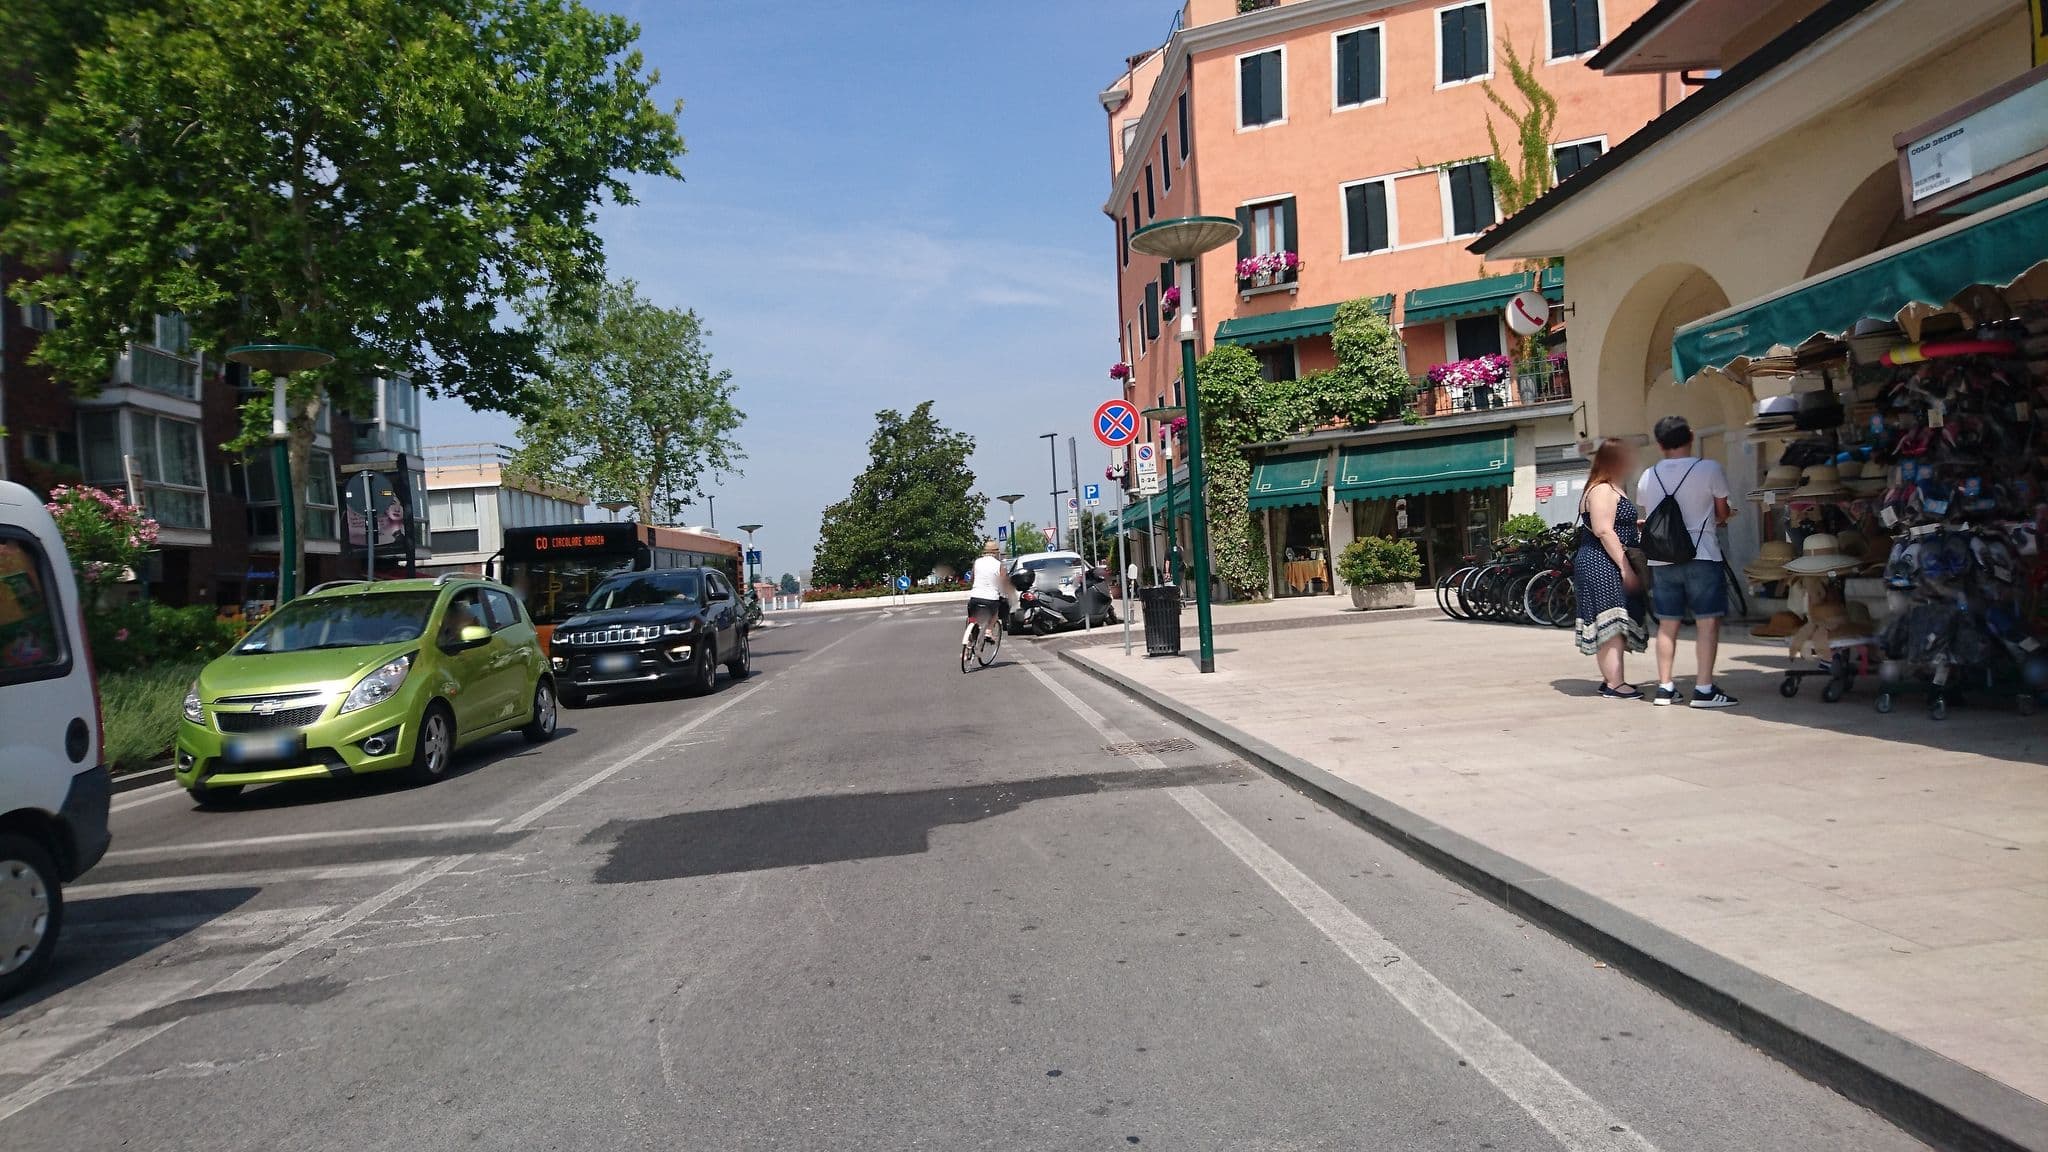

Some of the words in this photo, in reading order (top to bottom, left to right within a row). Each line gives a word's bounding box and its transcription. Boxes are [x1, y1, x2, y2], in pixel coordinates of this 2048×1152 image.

[1911, 143, 1931, 156] COLD
[1932, 127, 1964, 145] DRINKS
[1086, 486, 1097, 499] P
